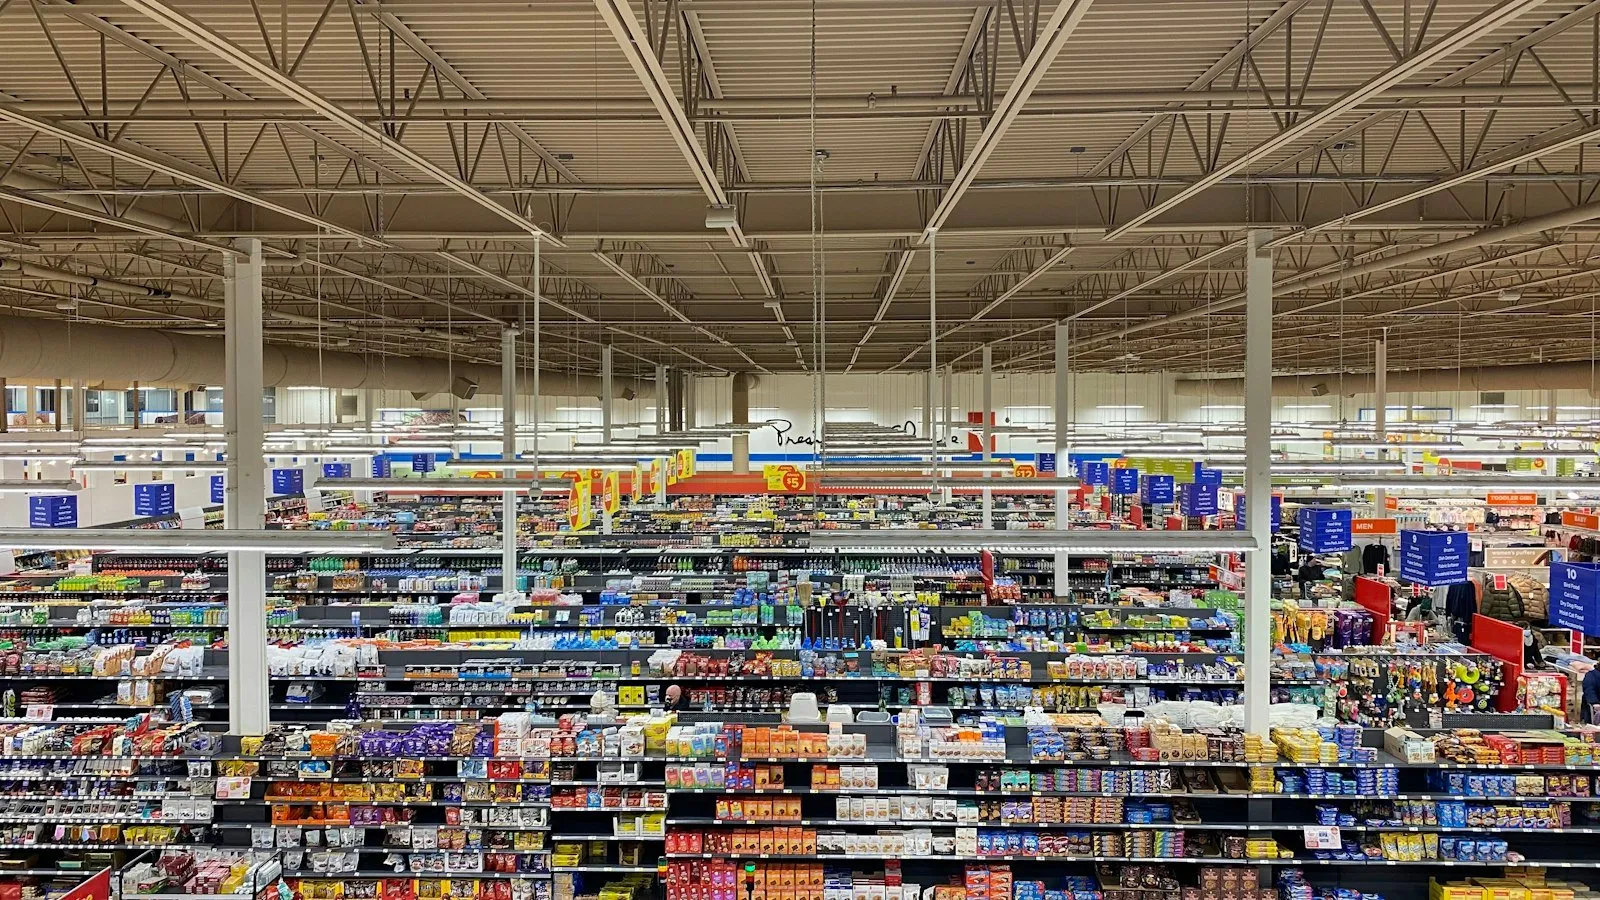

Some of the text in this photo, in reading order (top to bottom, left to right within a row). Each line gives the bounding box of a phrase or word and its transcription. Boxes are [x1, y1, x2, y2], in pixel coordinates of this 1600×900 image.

[786, 478, 799, 488] $5
[1412, 534, 1417, 543] 9
[1447, 536, 1452, 544] 9
[1566, 568, 1577, 580] 10
